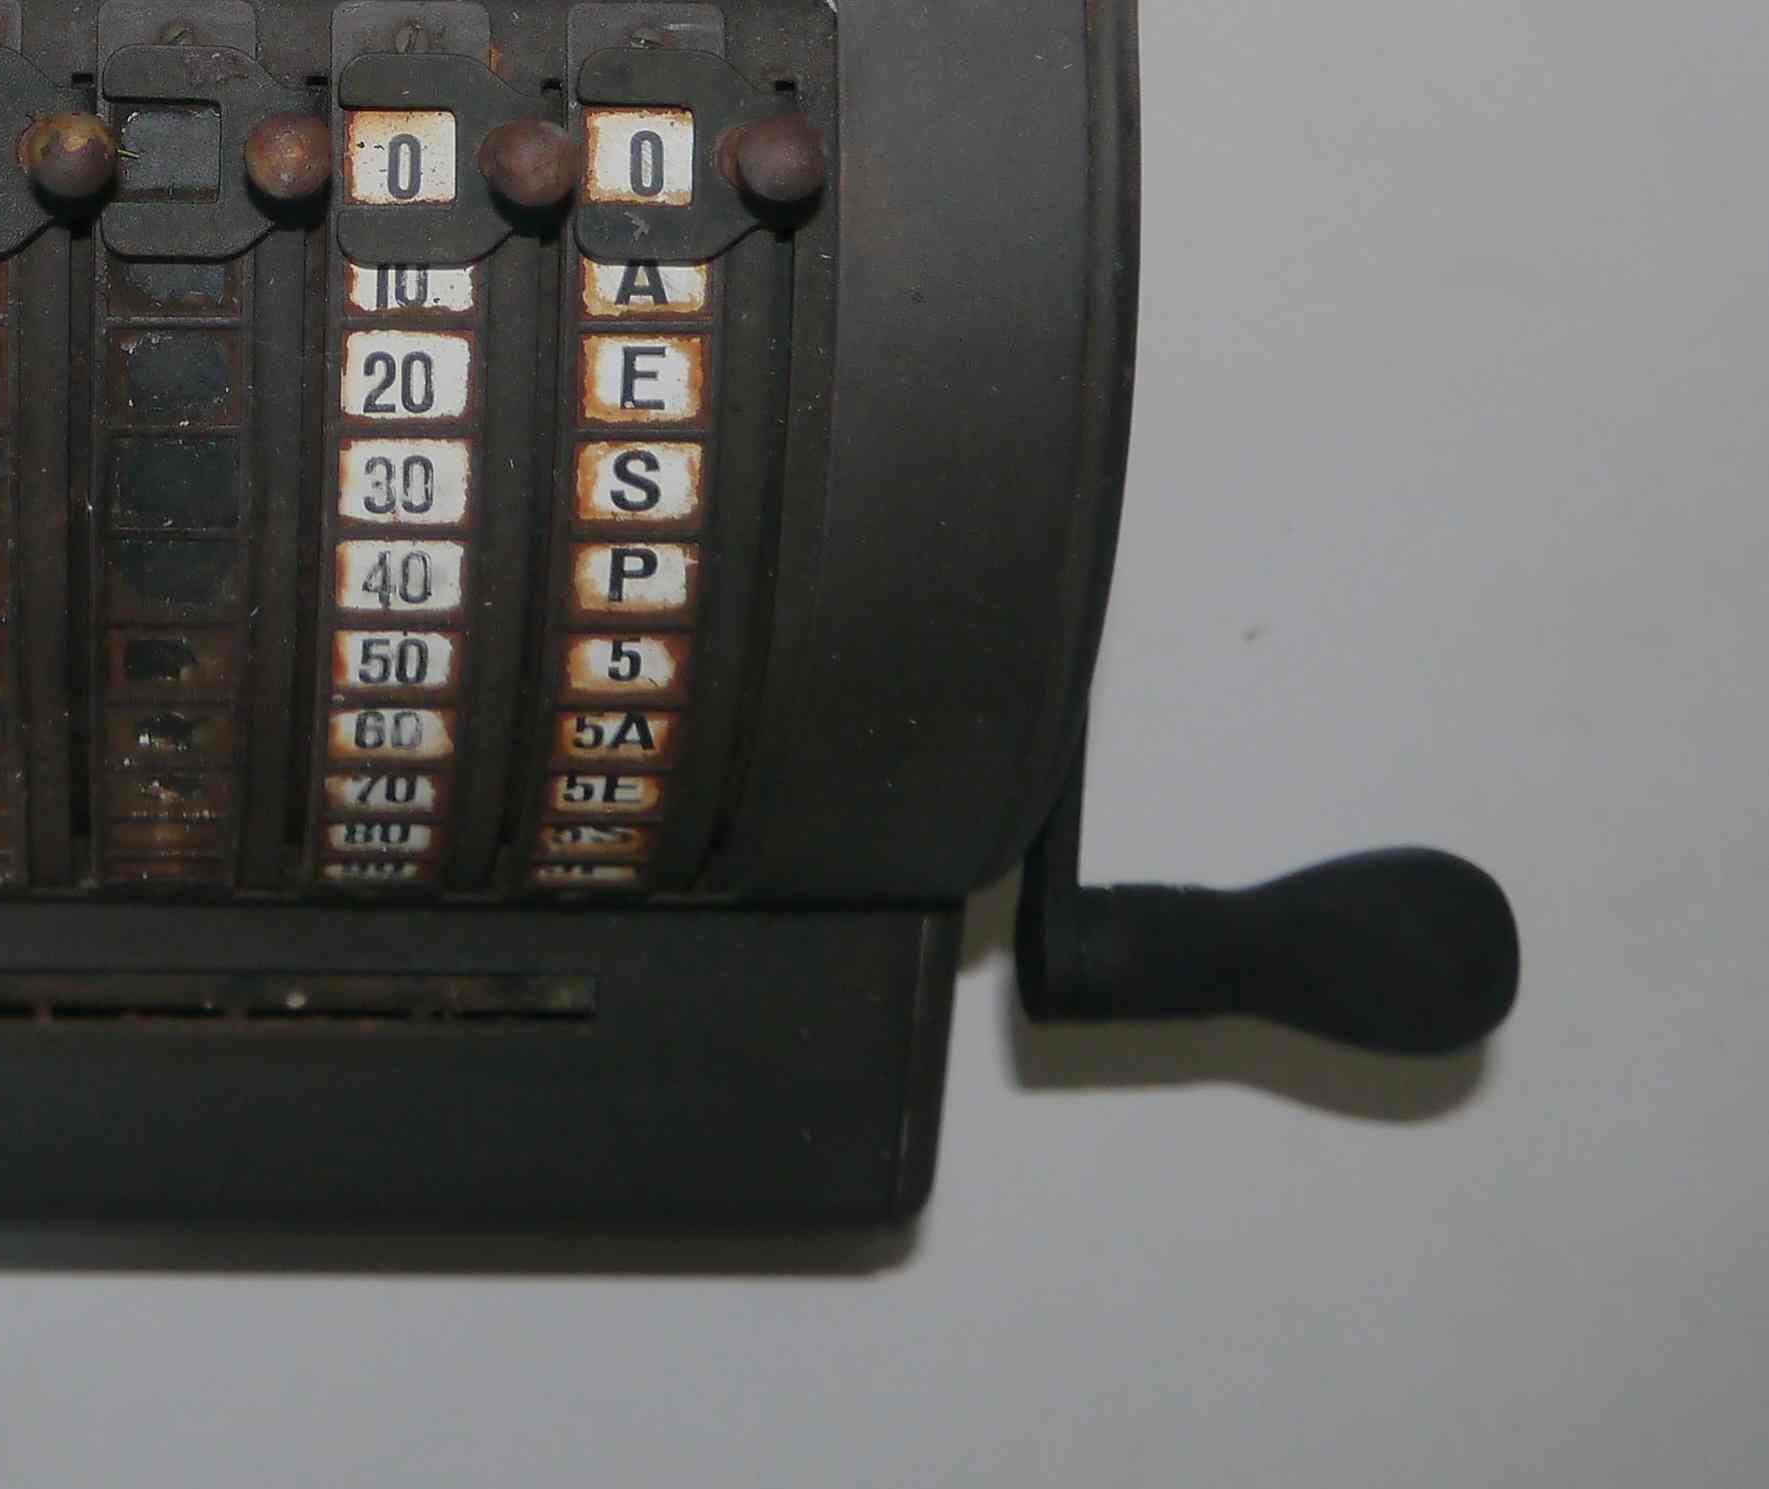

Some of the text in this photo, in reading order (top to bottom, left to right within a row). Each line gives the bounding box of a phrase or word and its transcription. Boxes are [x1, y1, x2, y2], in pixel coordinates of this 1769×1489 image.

[387, 133, 422, 200] 0
[630, 130, 664, 197] 0
[375, 263, 429, 308] 10
[615, 258, 668, 305] A
[363, 351, 433, 413] 20
[619, 345, 666, 410] E
[363, 455, 433, 513] 30
[610, 450, 662, 512] S
[361, 551, 433, 608] 40
[607, 548, 658, 602] P
[358, 638, 429, 684] 50
[607, 639, 641, 681] 5
[353, 711, 423, 751] 60
[572, 713, 656, 751] 5A
[354, 775, 417, 804] 70
[563, 775, 642, 804] 5E
